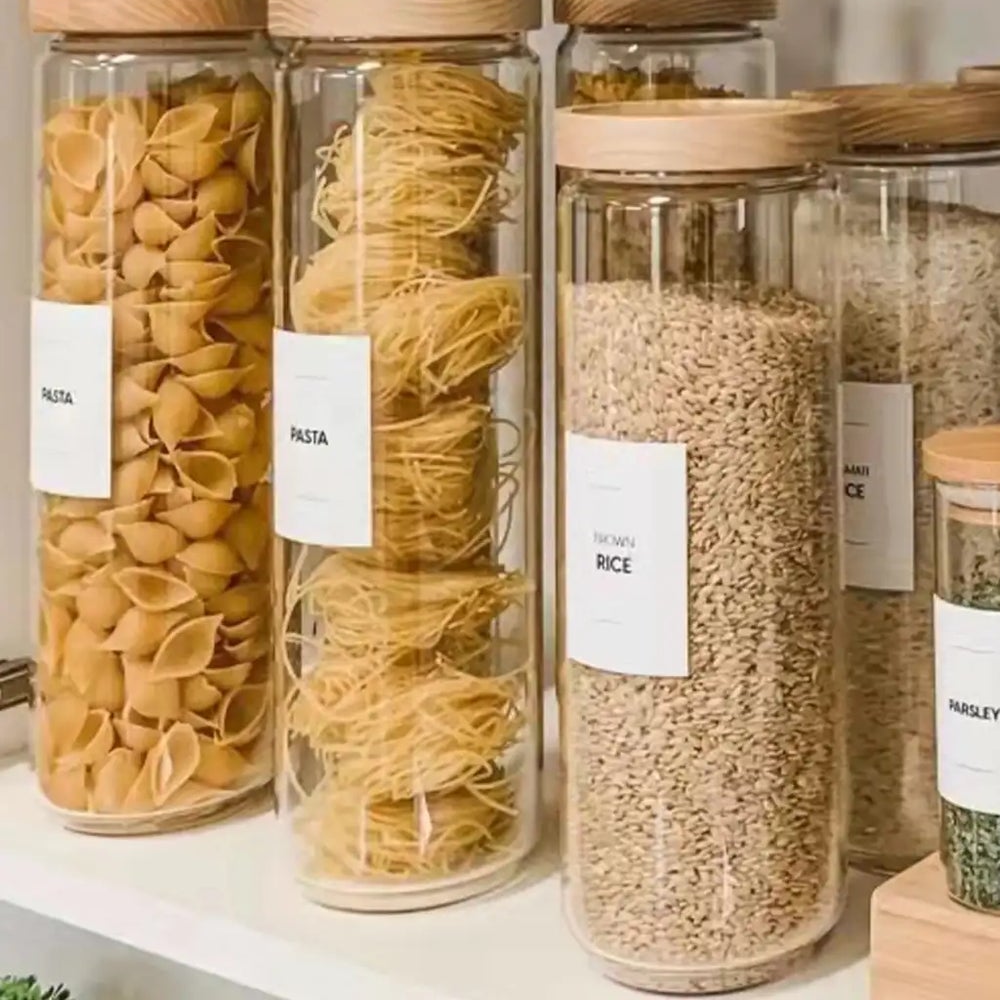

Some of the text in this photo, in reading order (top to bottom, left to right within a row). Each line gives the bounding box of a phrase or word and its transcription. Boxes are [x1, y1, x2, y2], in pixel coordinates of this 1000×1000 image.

[42, 387, 73, 405] PASTA
[290, 425, 328, 446] PASTA
[596, 553, 632, 574] RICE
[949, 699, 1000, 721] PARSLEY
